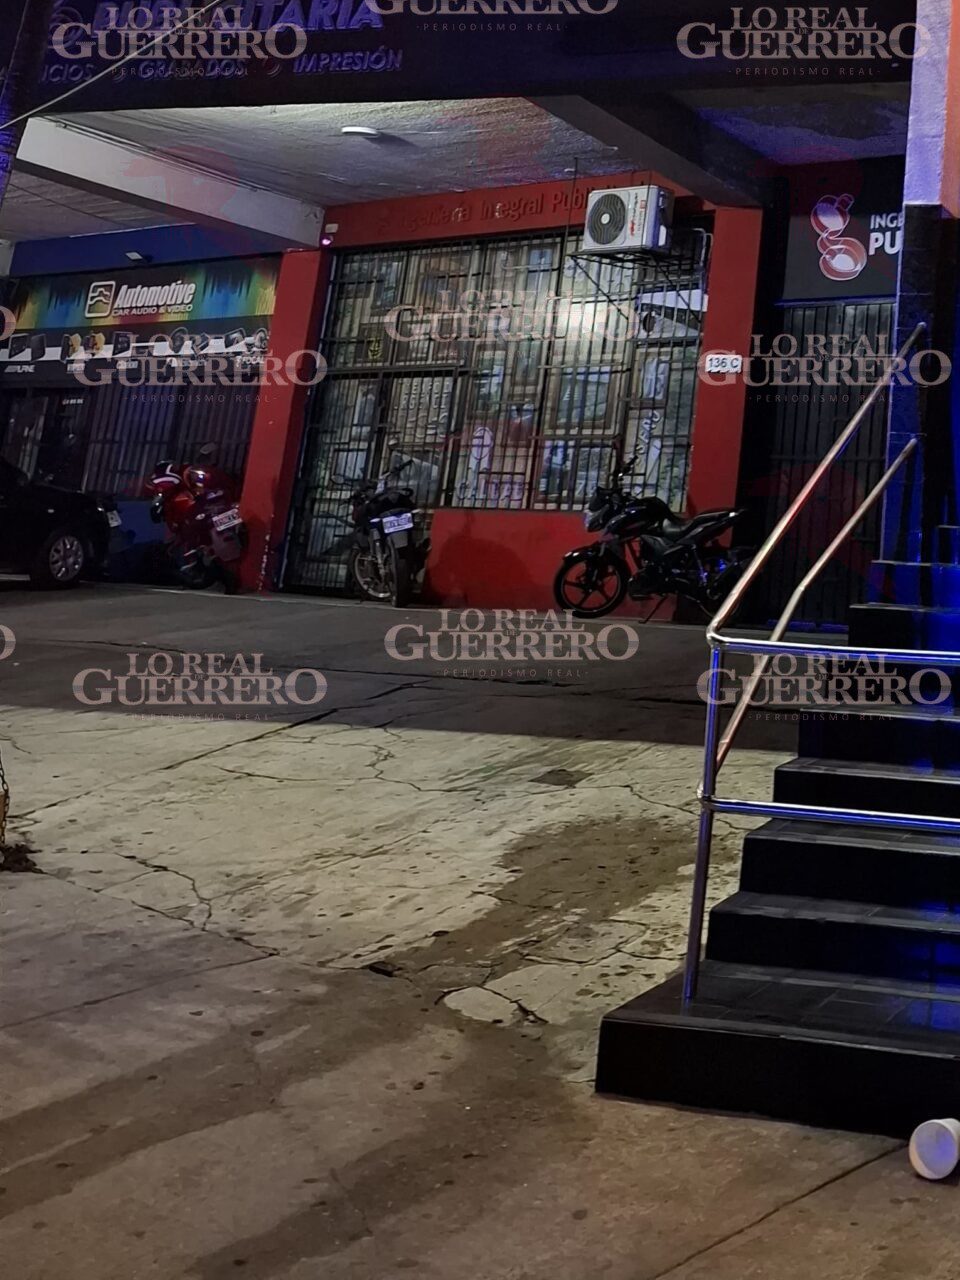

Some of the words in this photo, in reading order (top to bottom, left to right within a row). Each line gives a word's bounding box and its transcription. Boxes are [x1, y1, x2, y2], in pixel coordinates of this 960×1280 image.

[293, 44, 402, 75] IMPRESIÓN
[114, 280, 196, 308] Automotive
[111, 308, 130, 316] CAR
[132, 306, 157, 315] AUDIO
[167, 303, 194, 312] VIDEO
[707, 356, 727, 369] 136
